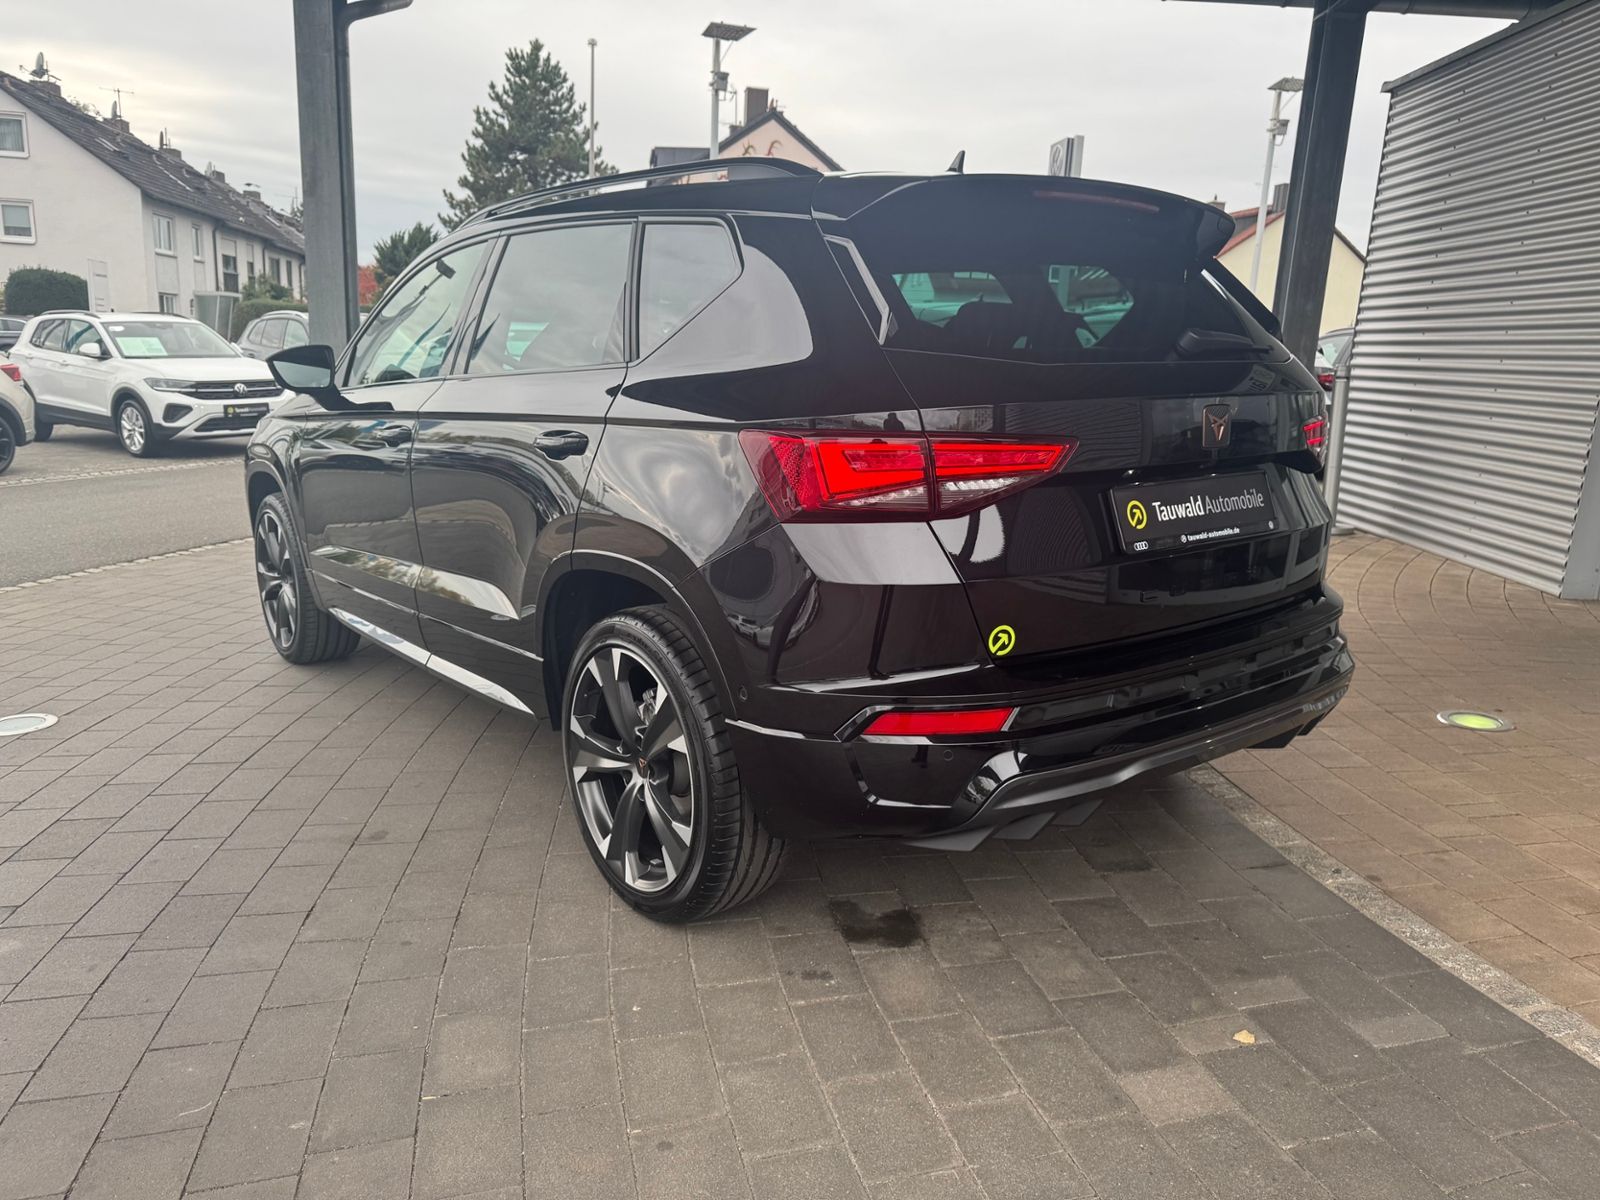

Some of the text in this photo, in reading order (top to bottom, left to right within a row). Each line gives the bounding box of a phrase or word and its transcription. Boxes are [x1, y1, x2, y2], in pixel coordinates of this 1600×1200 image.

[1152, 488, 1265, 522] Tauwald Automobile
[1187, 527, 1240, 541] tauwald-automobile.de
